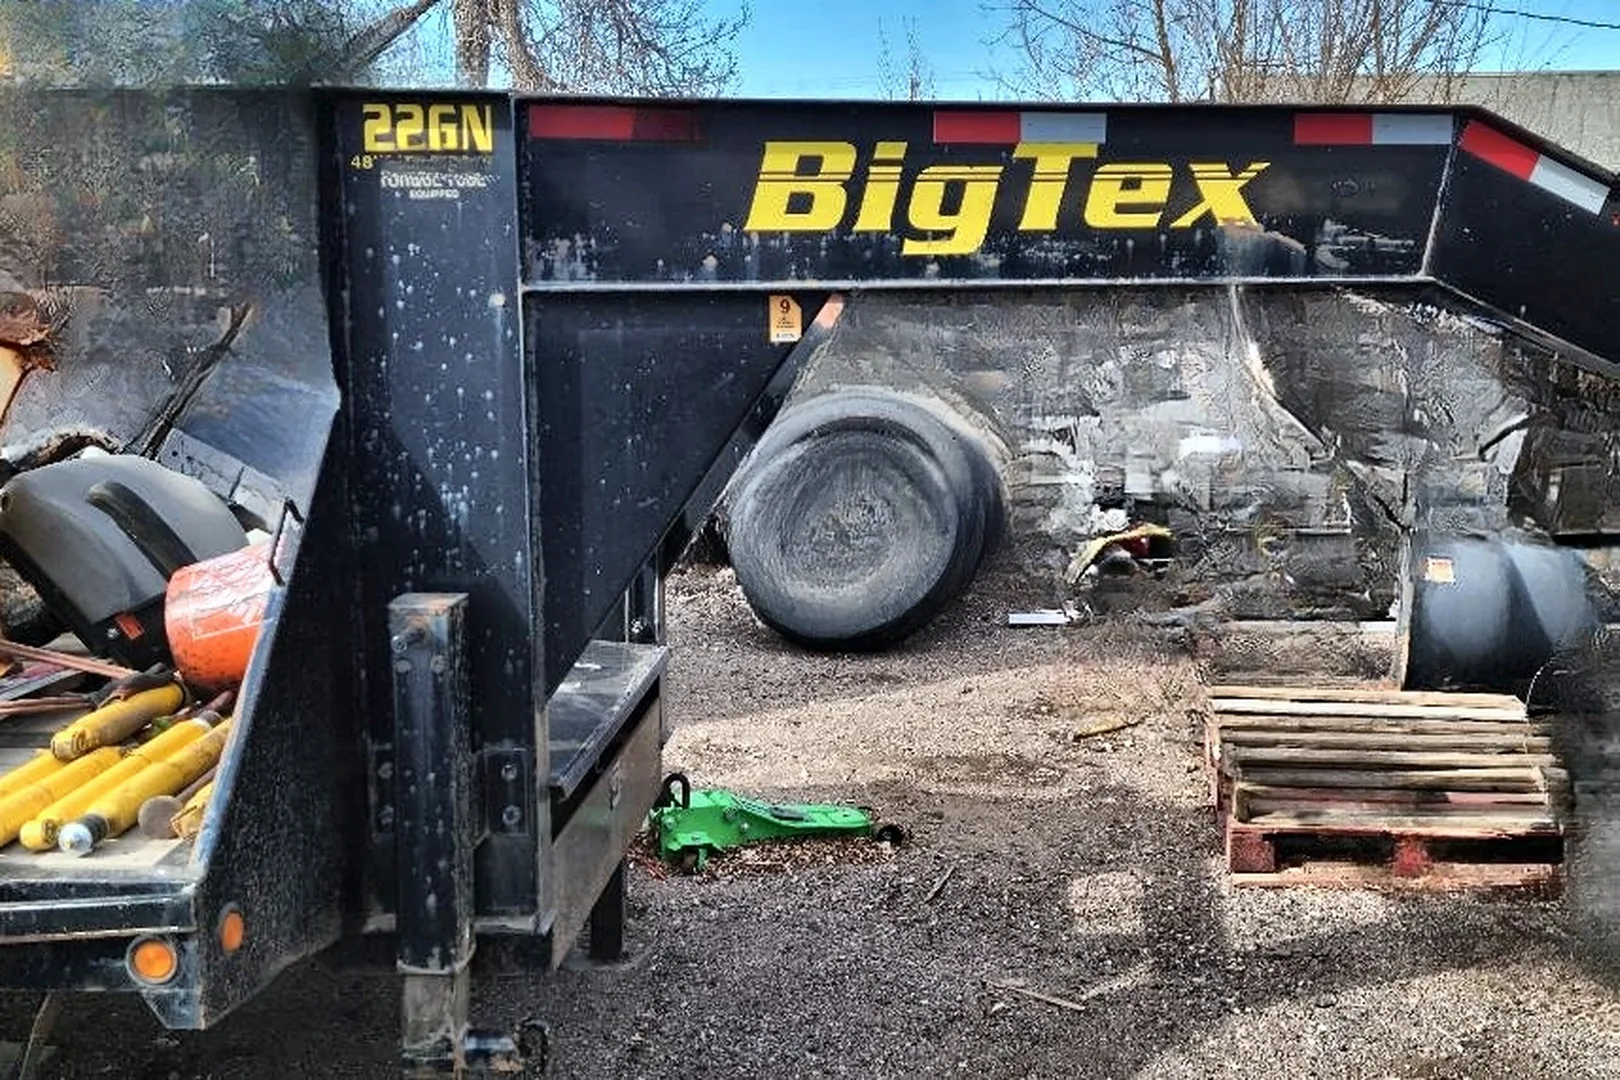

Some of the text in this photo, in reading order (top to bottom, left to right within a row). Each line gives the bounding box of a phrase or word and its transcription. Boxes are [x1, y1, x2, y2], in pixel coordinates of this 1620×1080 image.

[363, 103, 493, 152] 22GN
[744, 141, 1271, 256] BigTex
[779, 298, 791, 314] 9
